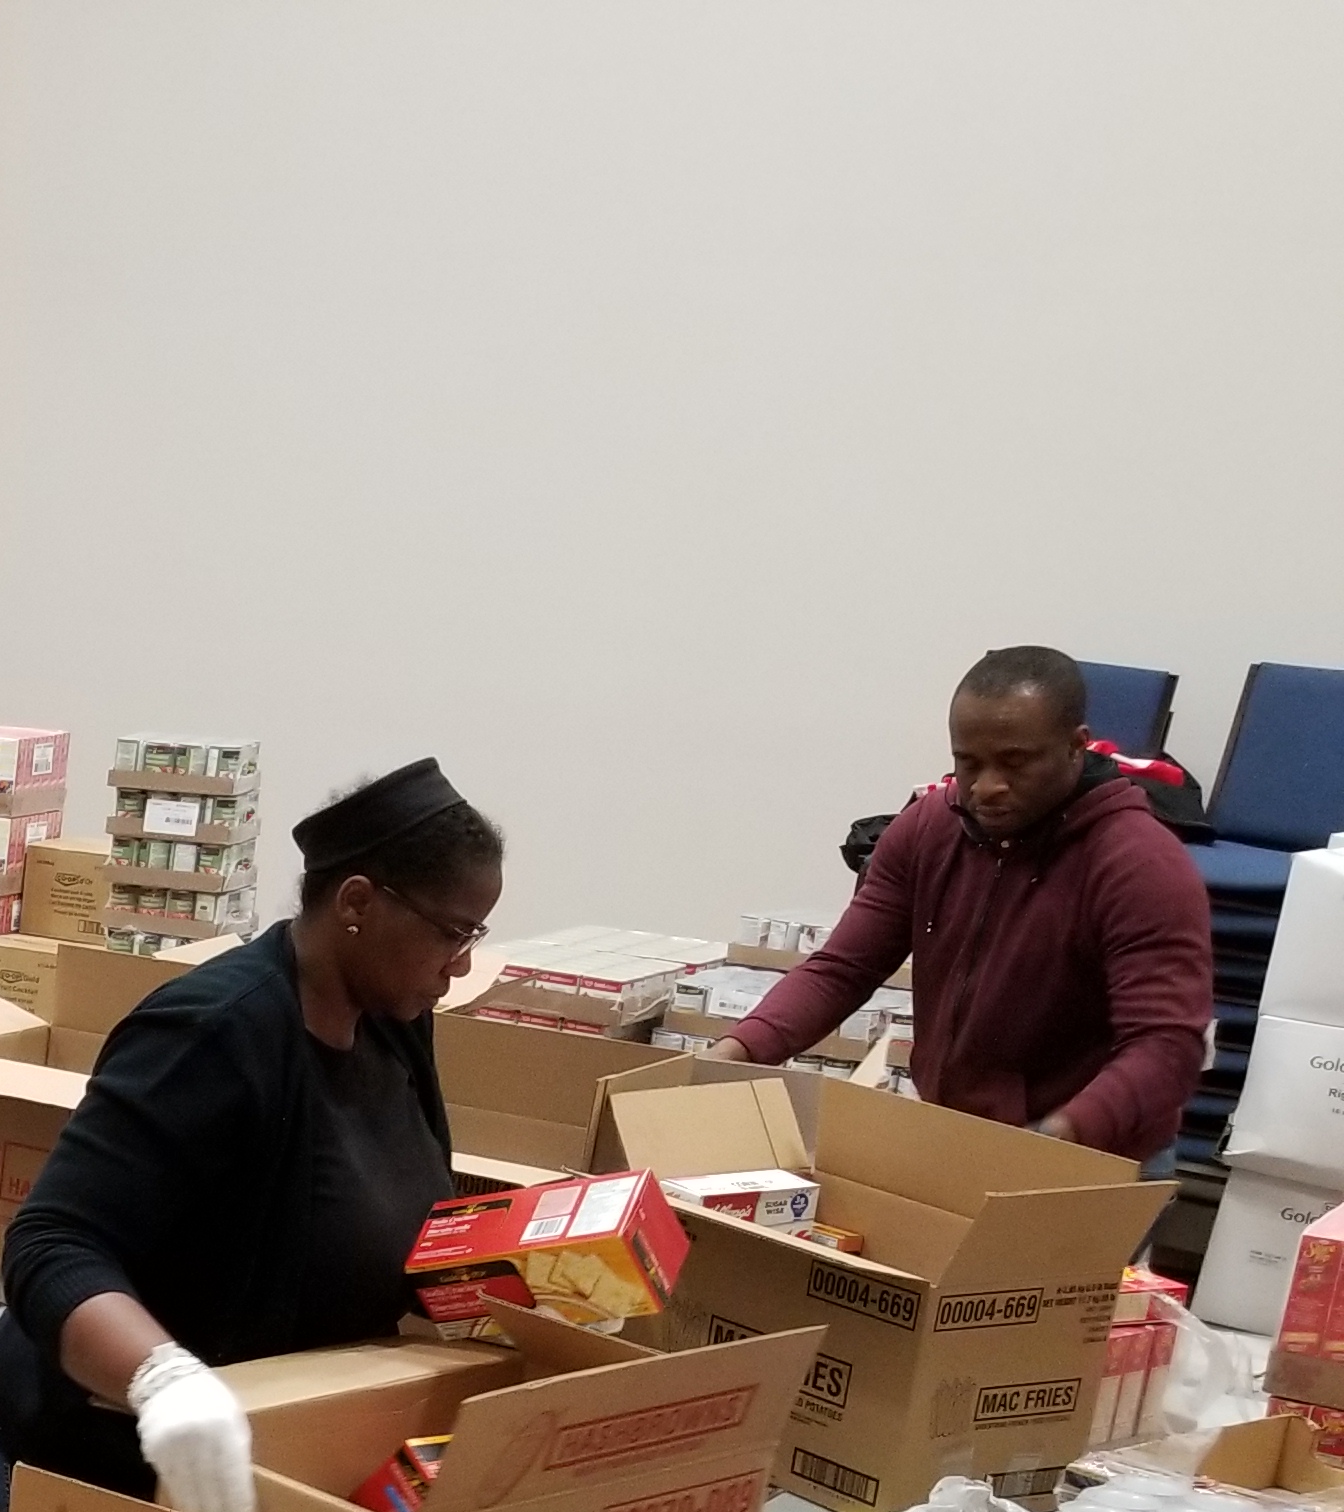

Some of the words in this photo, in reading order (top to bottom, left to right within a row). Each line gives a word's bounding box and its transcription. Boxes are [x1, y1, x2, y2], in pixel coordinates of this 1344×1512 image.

[813, 1266, 913, 1323] 00004-669
[939, 1293, 1038, 1325] 00004-669
[980, 1393, 1019, 1414] MAC
[1022, 1385, 1073, 1411] FRIES
